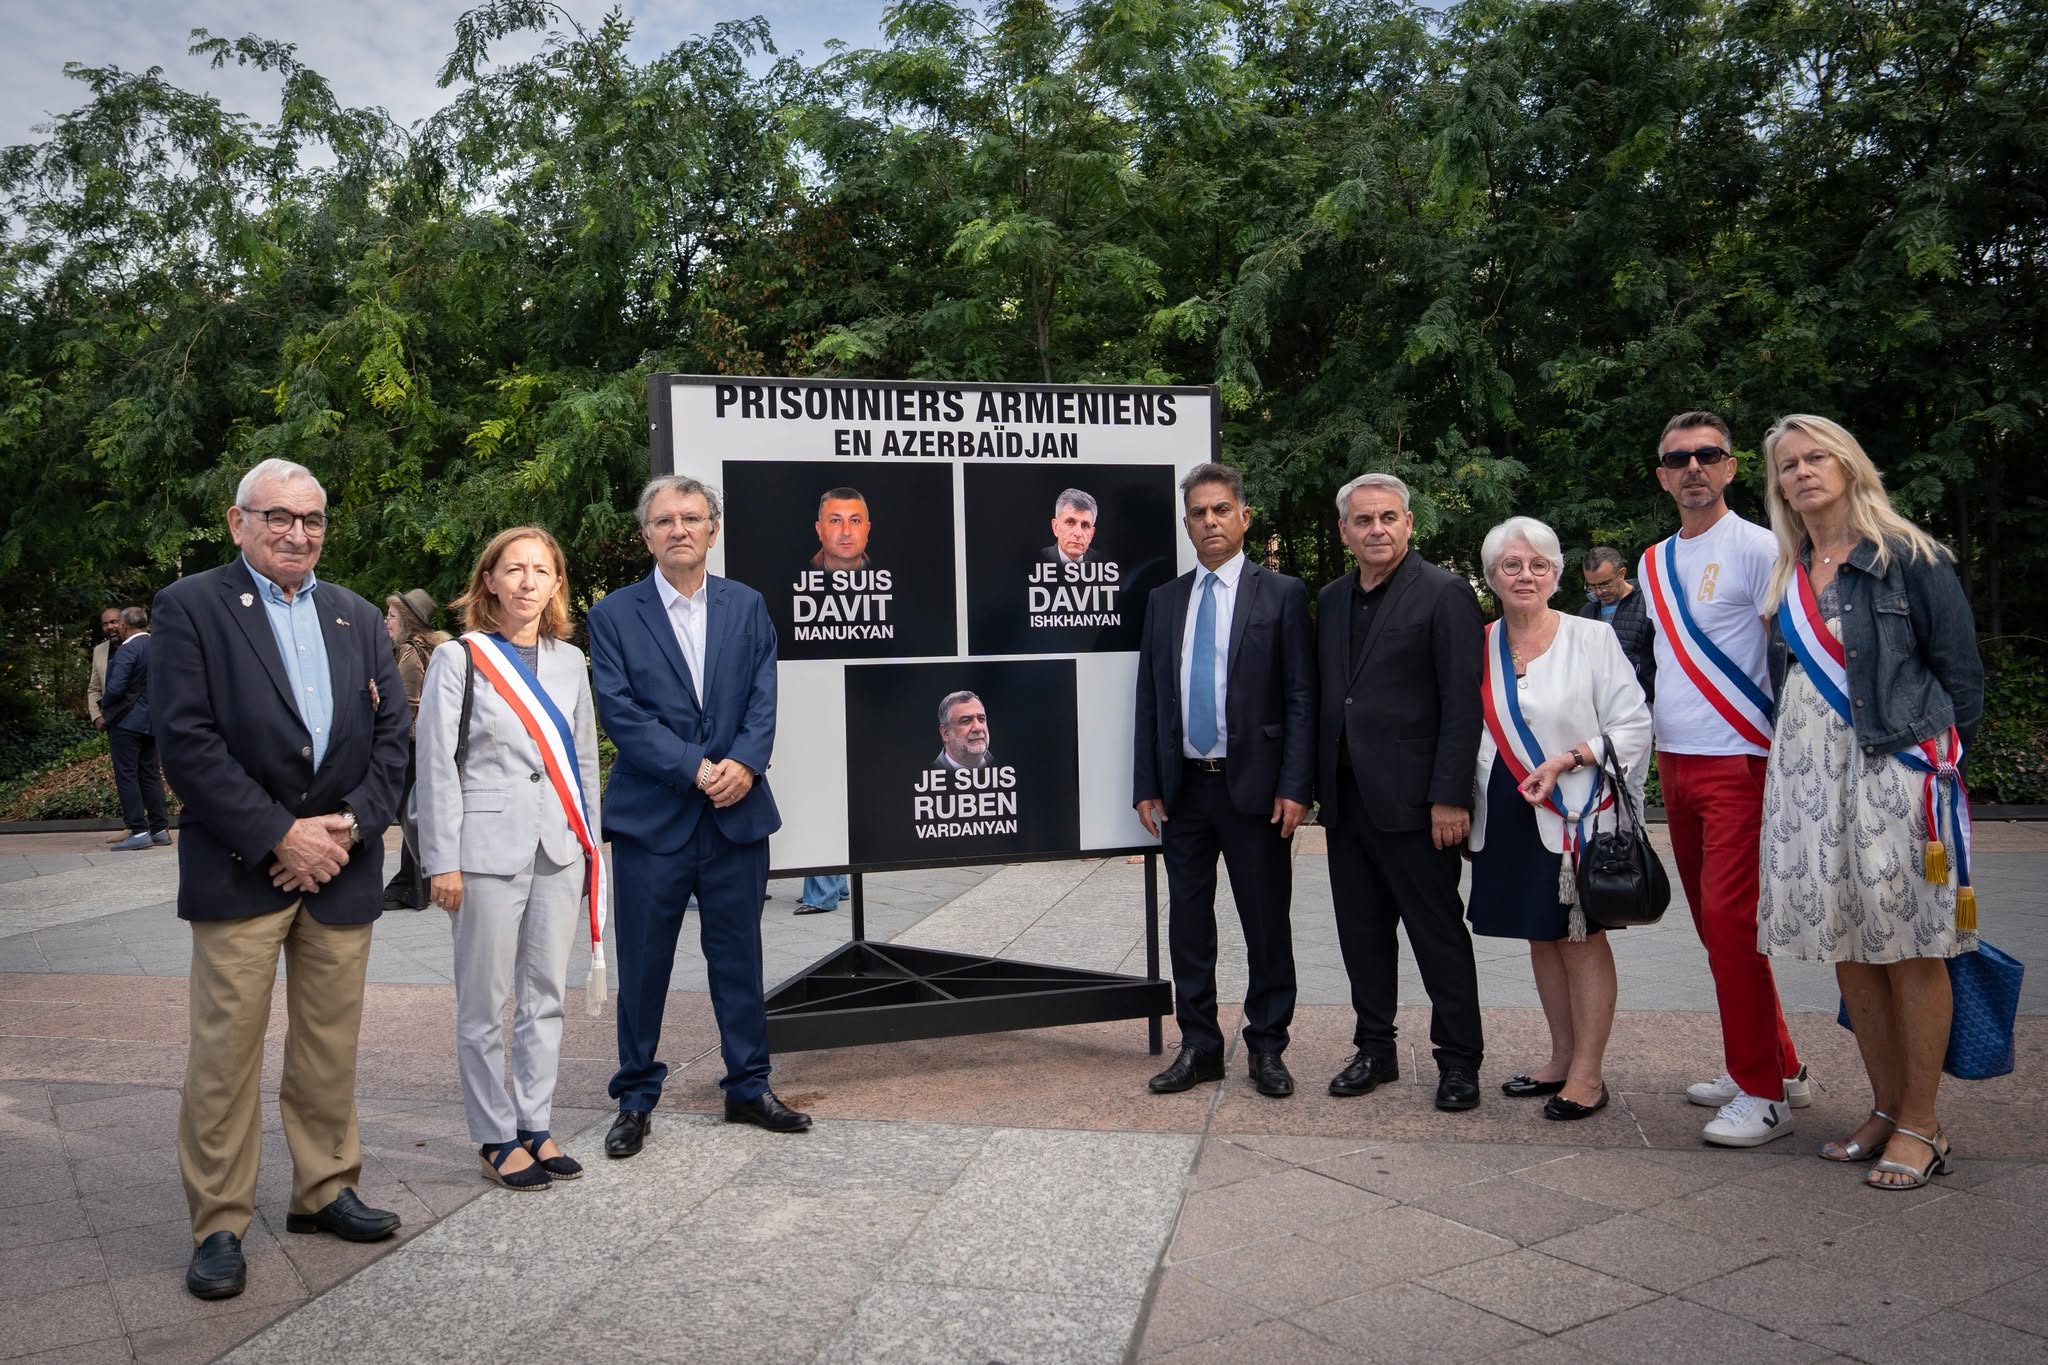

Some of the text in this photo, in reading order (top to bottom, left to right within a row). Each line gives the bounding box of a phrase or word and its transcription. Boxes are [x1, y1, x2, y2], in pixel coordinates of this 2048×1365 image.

[715, 384, 1177, 426] PRISONNIERS ARMENIENS
[835, 425, 1078, 458] EN AZERBAÏDJAN
[792, 569, 893, 592] JE SUIS
[1028, 561, 1120, 584] JE SUIS
[793, 593, 893, 623] DAVIT
[1028, 585, 1120, 613] DAVIT
[794, 624, 894, 641] MANUKYAN
[1030, 613, 1121, 628] ISHKHANYAN
[914, 765, 1017, 793] JE SUIS
[914, 791, 1017, 821] RUBEN
[915, 819, 1018, 839] VARDANYAN
